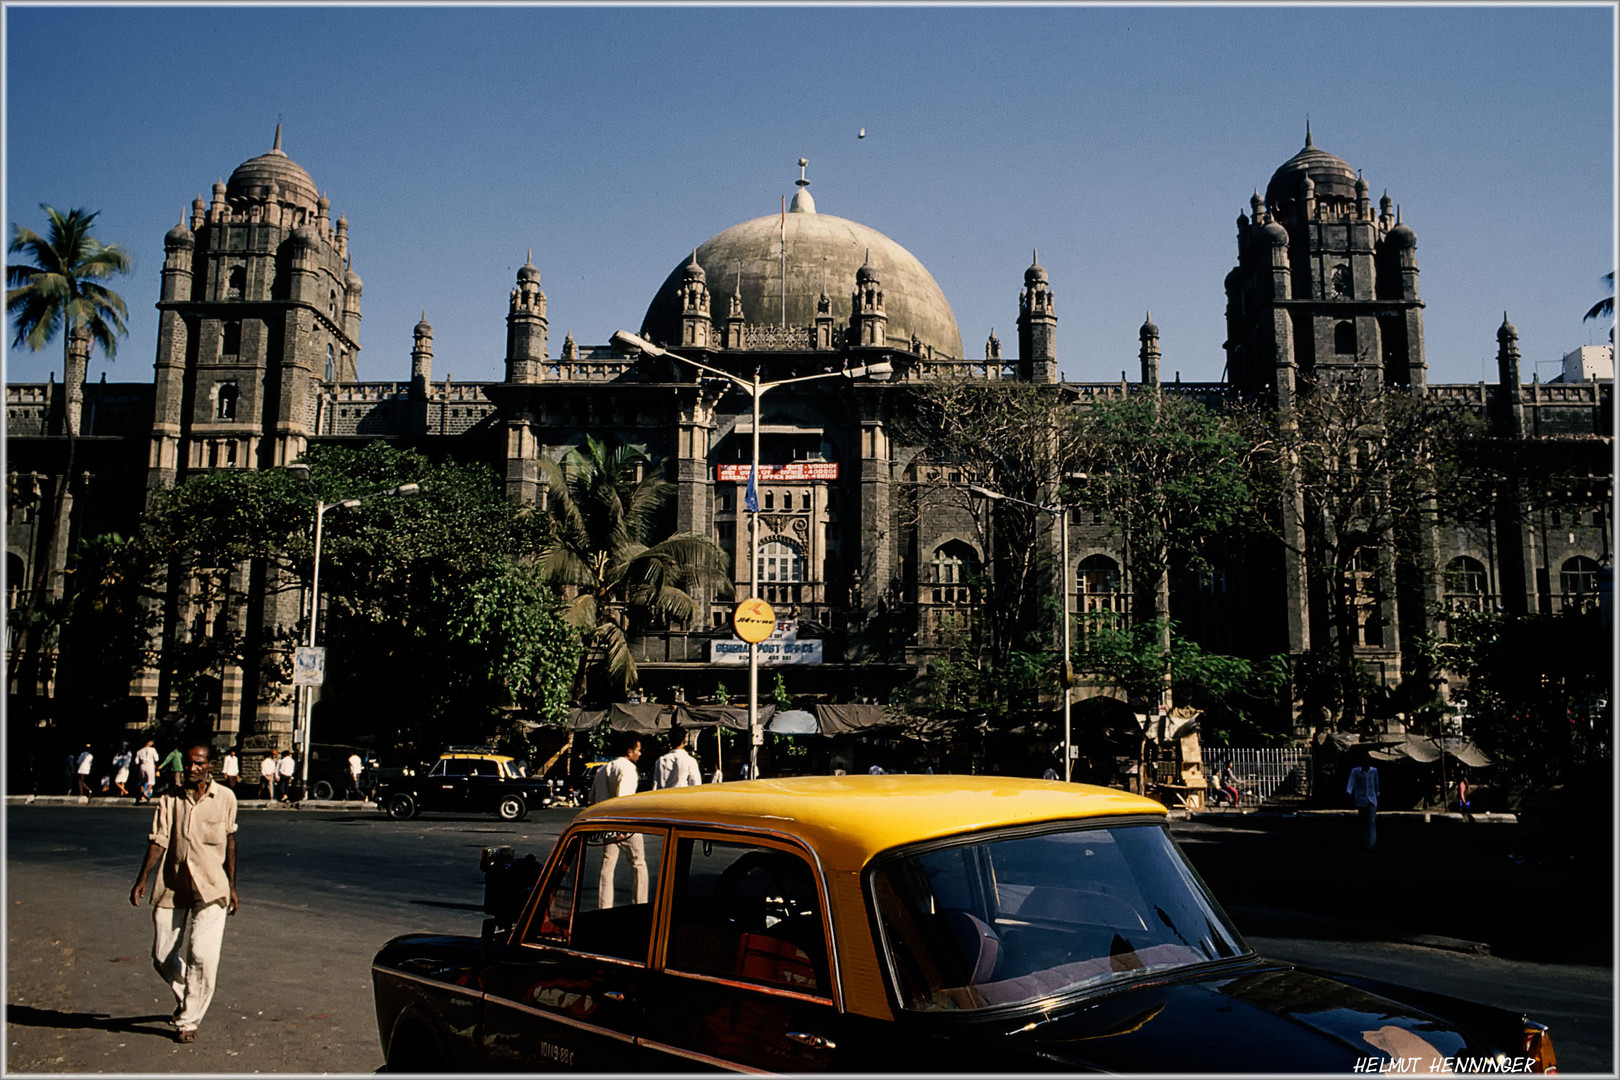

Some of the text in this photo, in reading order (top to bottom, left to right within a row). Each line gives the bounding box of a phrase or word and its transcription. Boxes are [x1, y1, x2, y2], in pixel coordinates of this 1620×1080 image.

[716, 643, 814, 653] GENERA POST OFFICE
